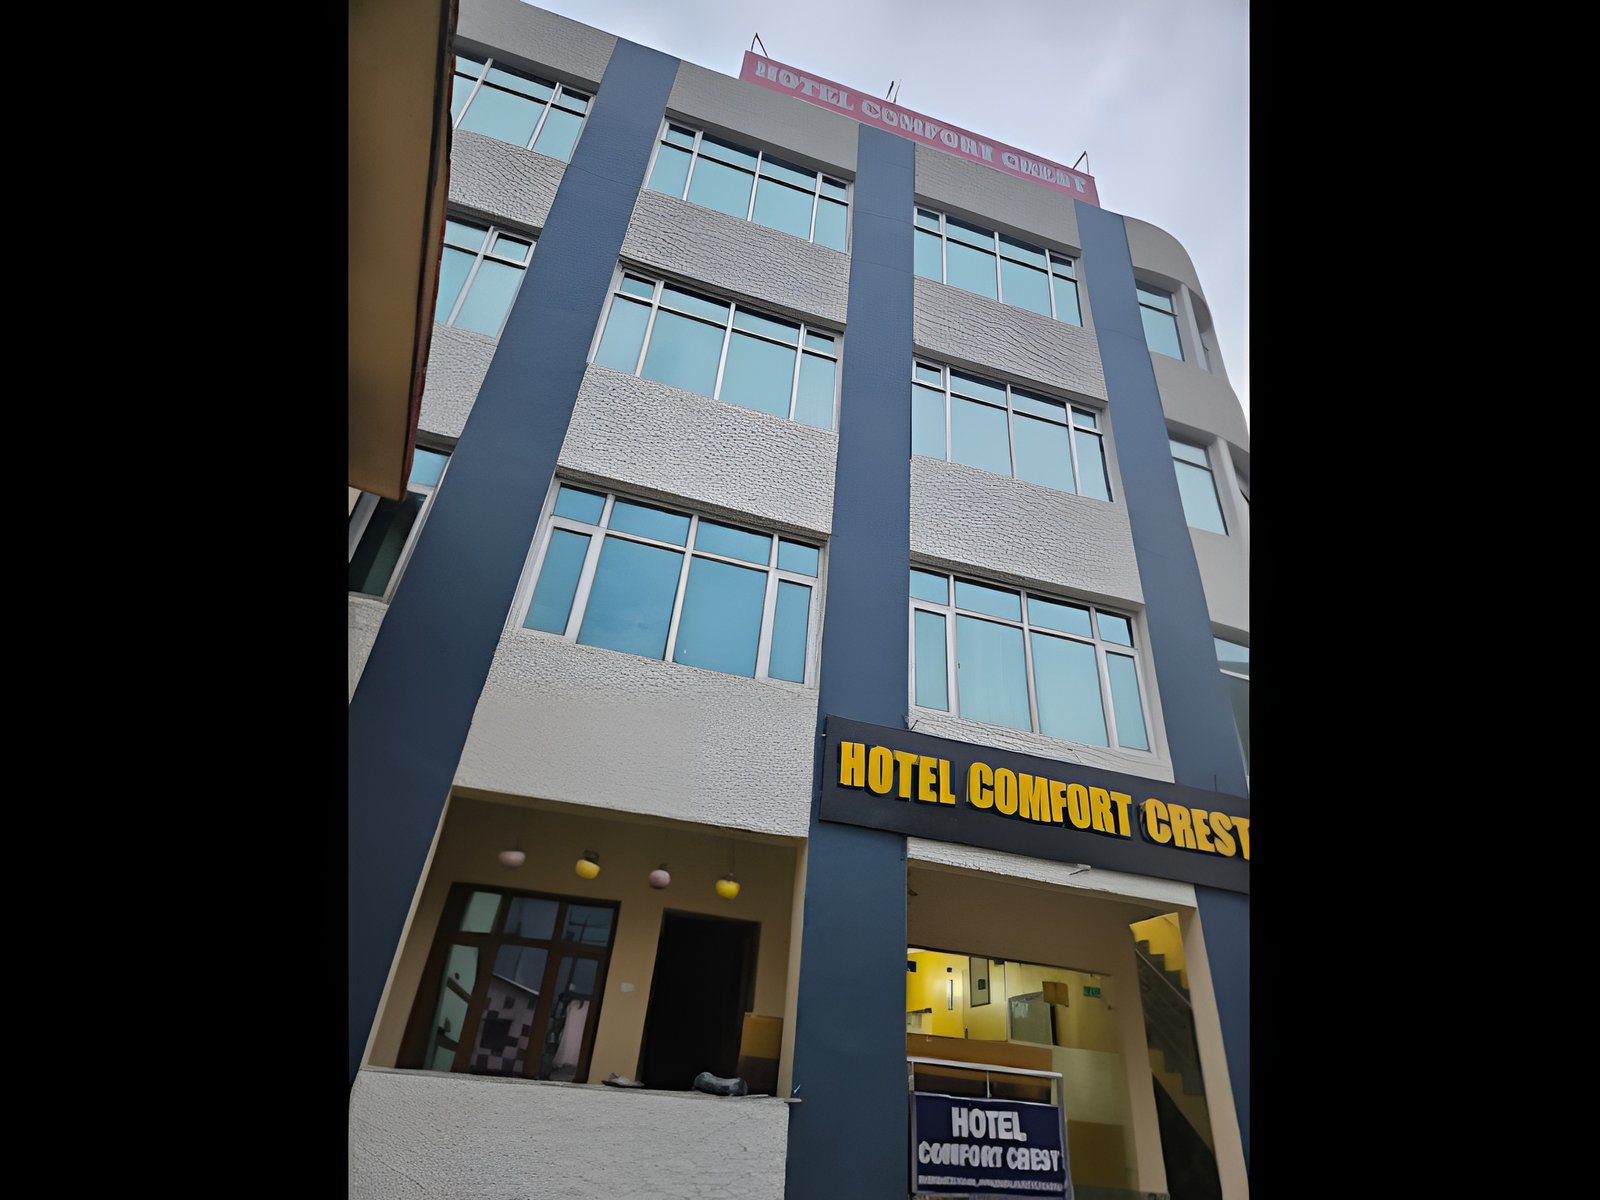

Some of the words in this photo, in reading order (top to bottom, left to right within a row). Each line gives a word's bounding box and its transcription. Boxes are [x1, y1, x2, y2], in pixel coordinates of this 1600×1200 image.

[755, 60, 855, 112] HOTEL
[839, 741, 957, 806] HOTEL
[967, 761, 1132, 837] COMFORT
[1143, 798, 1250, 861] CREST
[951, 1106, 1028, 1142] HOTEL
[1006, 1147, 1060, 1172] CREST
